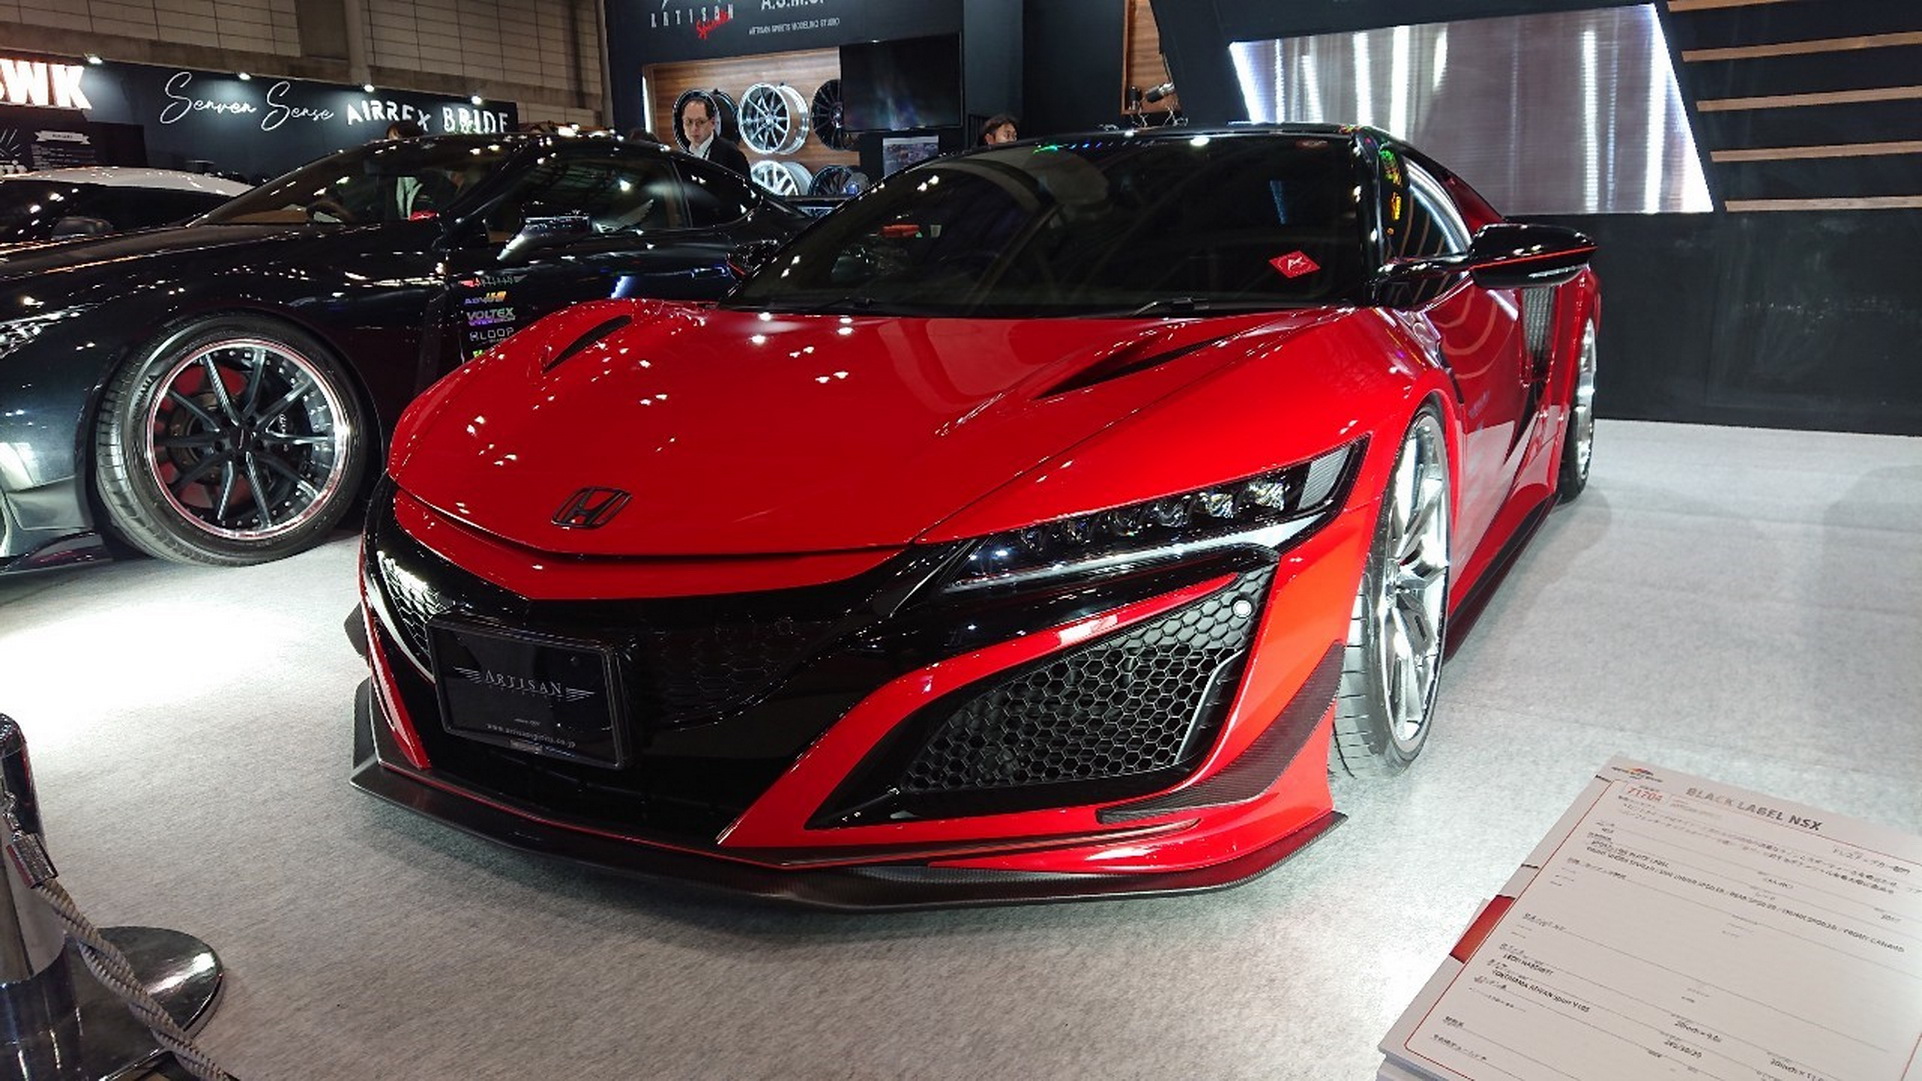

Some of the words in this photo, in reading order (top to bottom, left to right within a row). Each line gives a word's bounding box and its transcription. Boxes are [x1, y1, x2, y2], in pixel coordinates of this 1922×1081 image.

[0, 58, 93, 110] WK
[261, 81, 334, 131] Sense
[466, 307, 515, 321] VOLTEX
[486, 669, 563, 696] ARTISAN
[1737, 801, 1784, 821] LABEL
[1788, 814, 1824, 831] NSX
